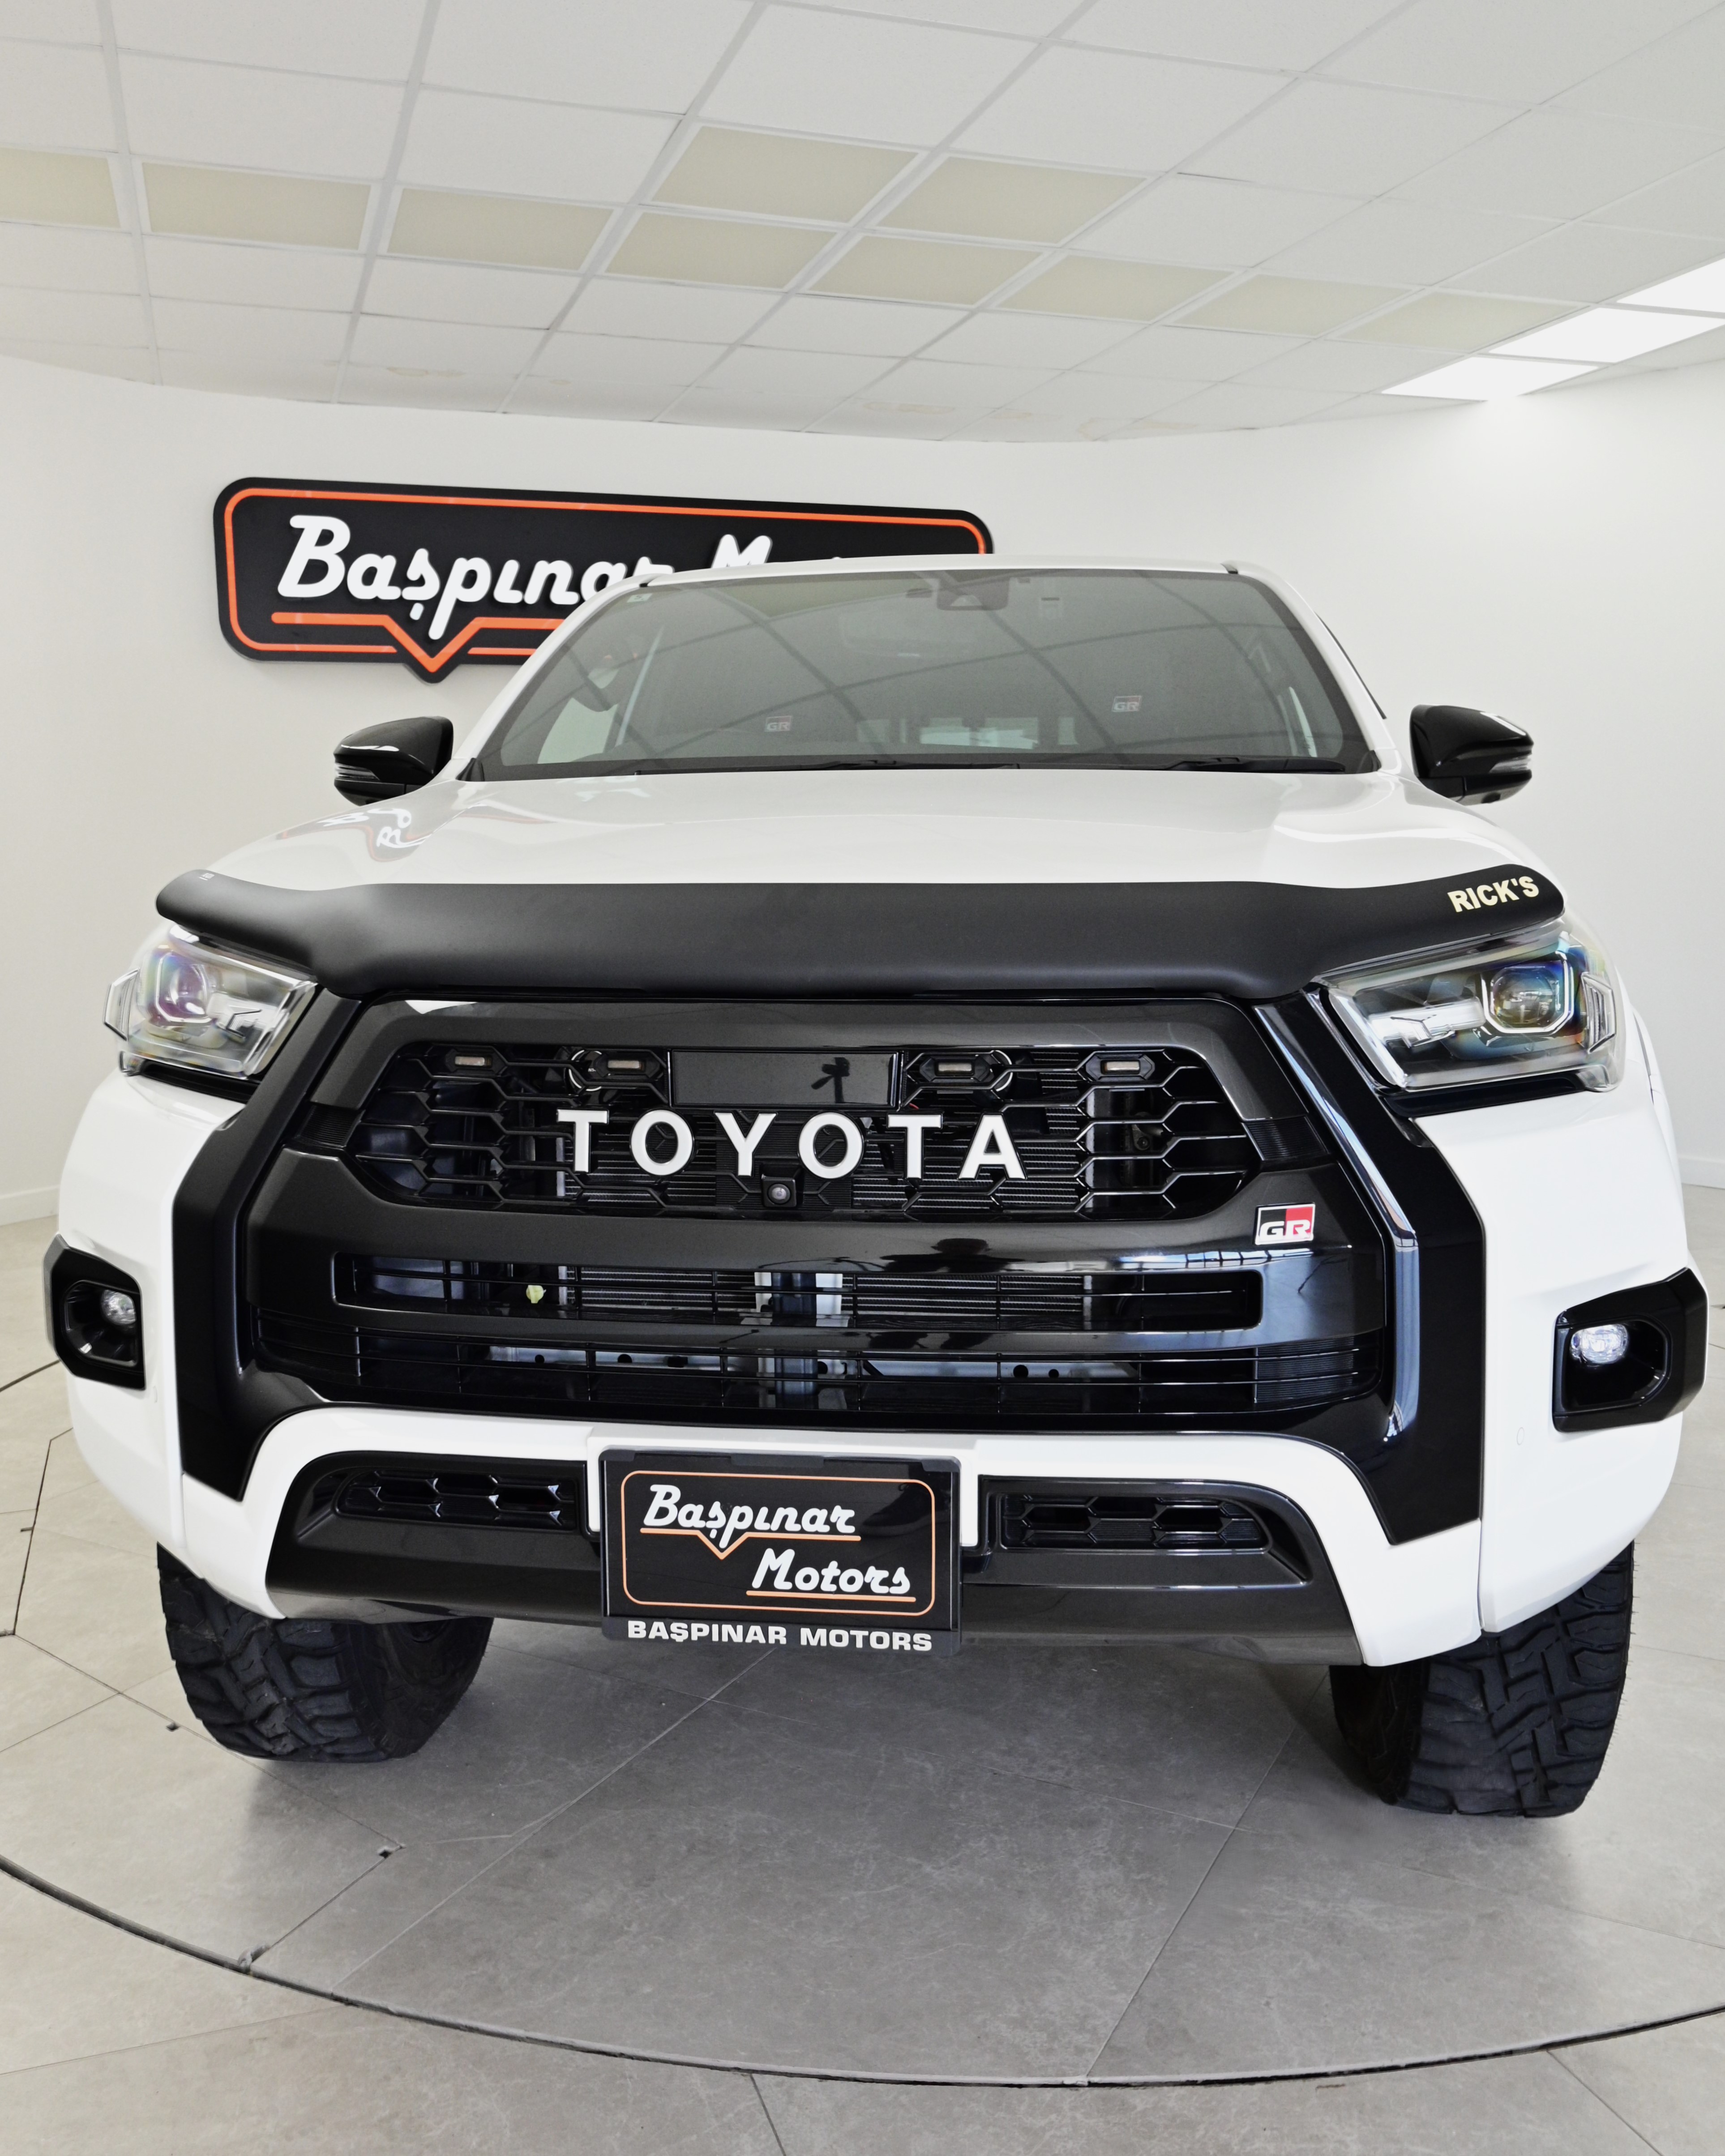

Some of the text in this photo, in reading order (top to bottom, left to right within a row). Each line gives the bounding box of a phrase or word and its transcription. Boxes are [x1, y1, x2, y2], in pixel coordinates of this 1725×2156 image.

[1447, 876, 1539, 912] RICK'S
[557, 1108, 1027, 1179] TOYOTA
[1259, 1219, 1311, 1241] GR
[751, 1548, 911, 1594] Motors
[627, 1620, 933, 1652] BAŞPINAR MOTORS
